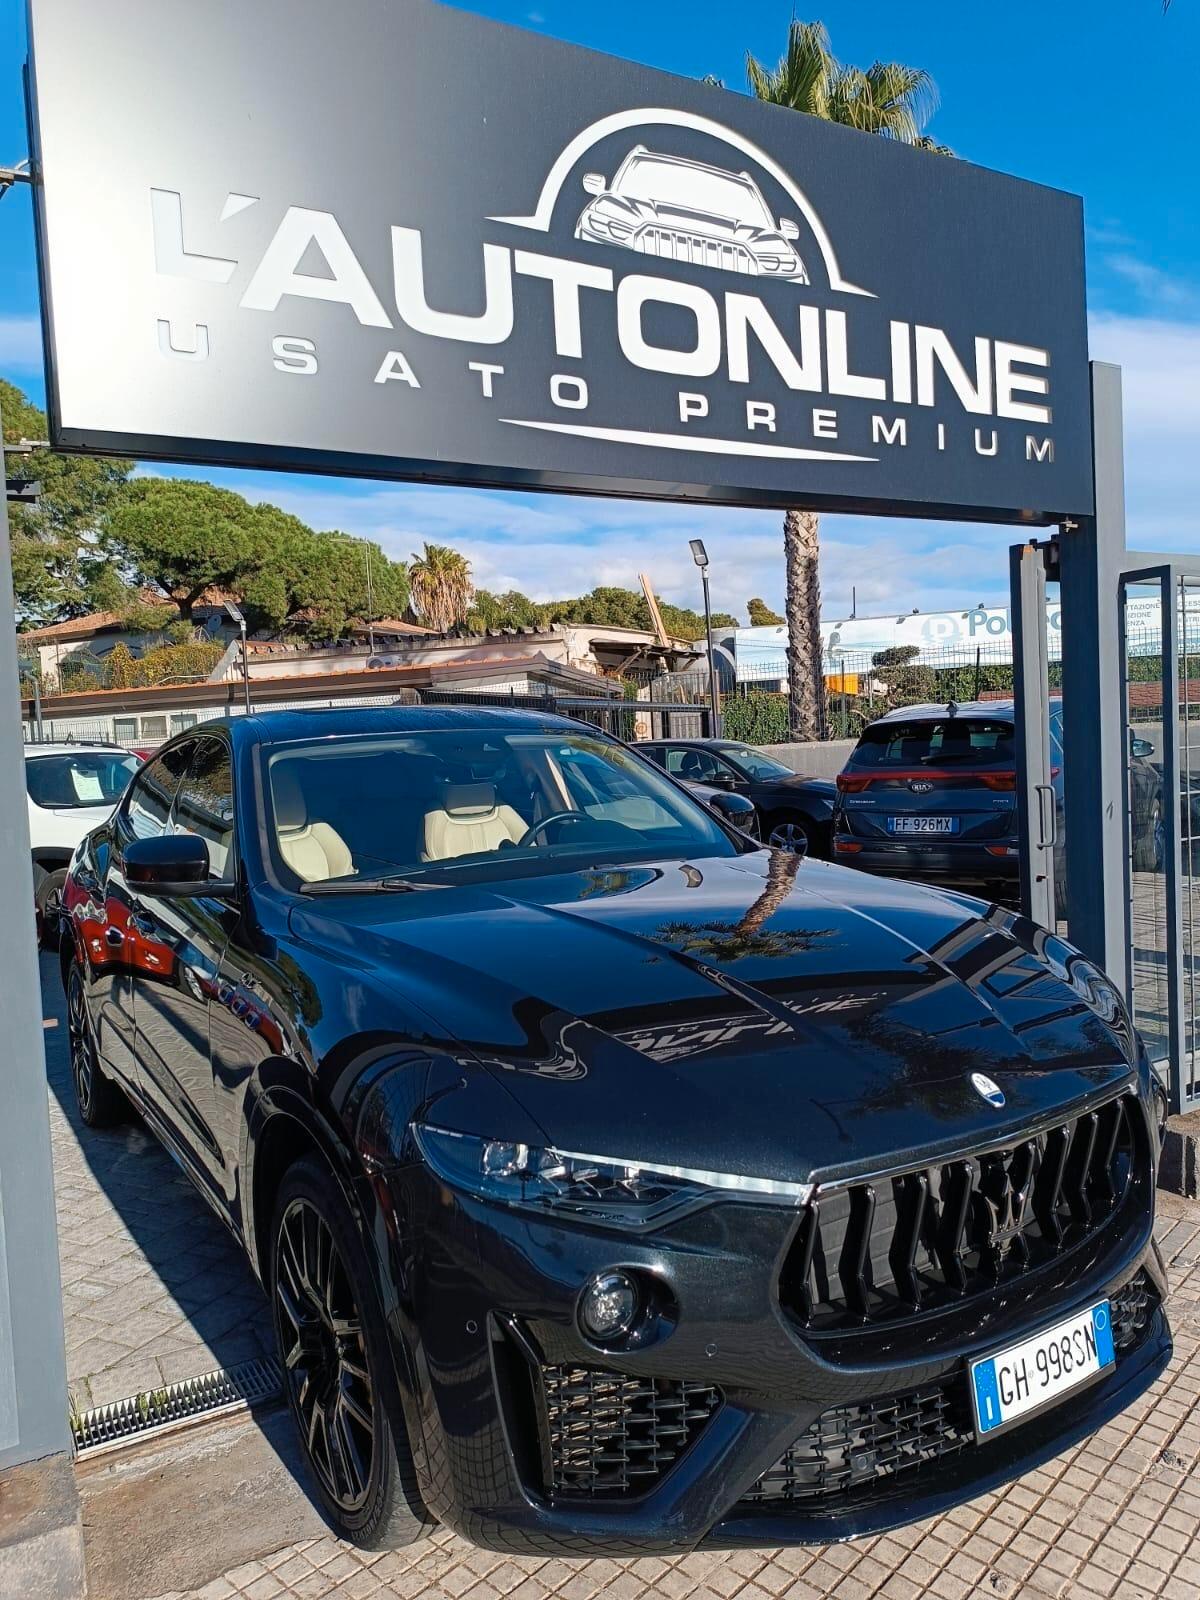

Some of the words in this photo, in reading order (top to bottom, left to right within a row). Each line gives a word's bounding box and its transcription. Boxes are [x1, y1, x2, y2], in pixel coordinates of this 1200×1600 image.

[150, 187, 1053, 424] L'AUTONLINE
[156, 318, 588, 409] USATO
[678, 391, 1055, 463] PREMIUM
[895, 818, 910, 831] FF
[913, 818, 951, 831] 926MX
[999, 1358, 1030, 1406] GH
[1035, 1320, 1098, 1387] 998SN
